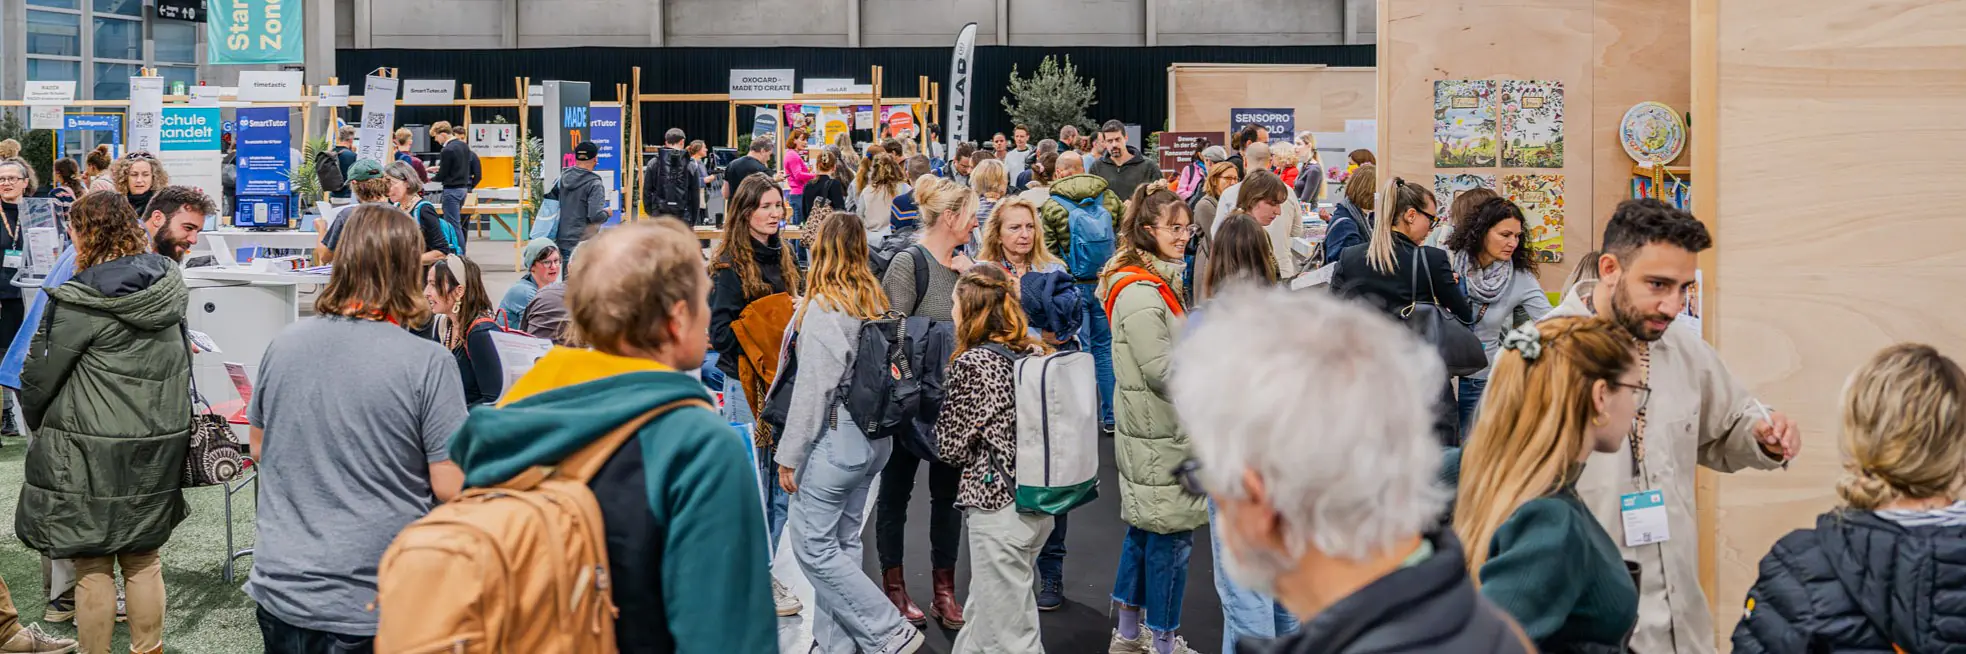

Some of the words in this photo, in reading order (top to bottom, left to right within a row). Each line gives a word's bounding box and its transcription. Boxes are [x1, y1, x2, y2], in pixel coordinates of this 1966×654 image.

[954, 58, 966, 141] uLAB
[249, 119, 287, 127] SmartTutor
[564, 106, 587, 128] MADE
[1235, 113, 1290, 123] SENSOPRO
